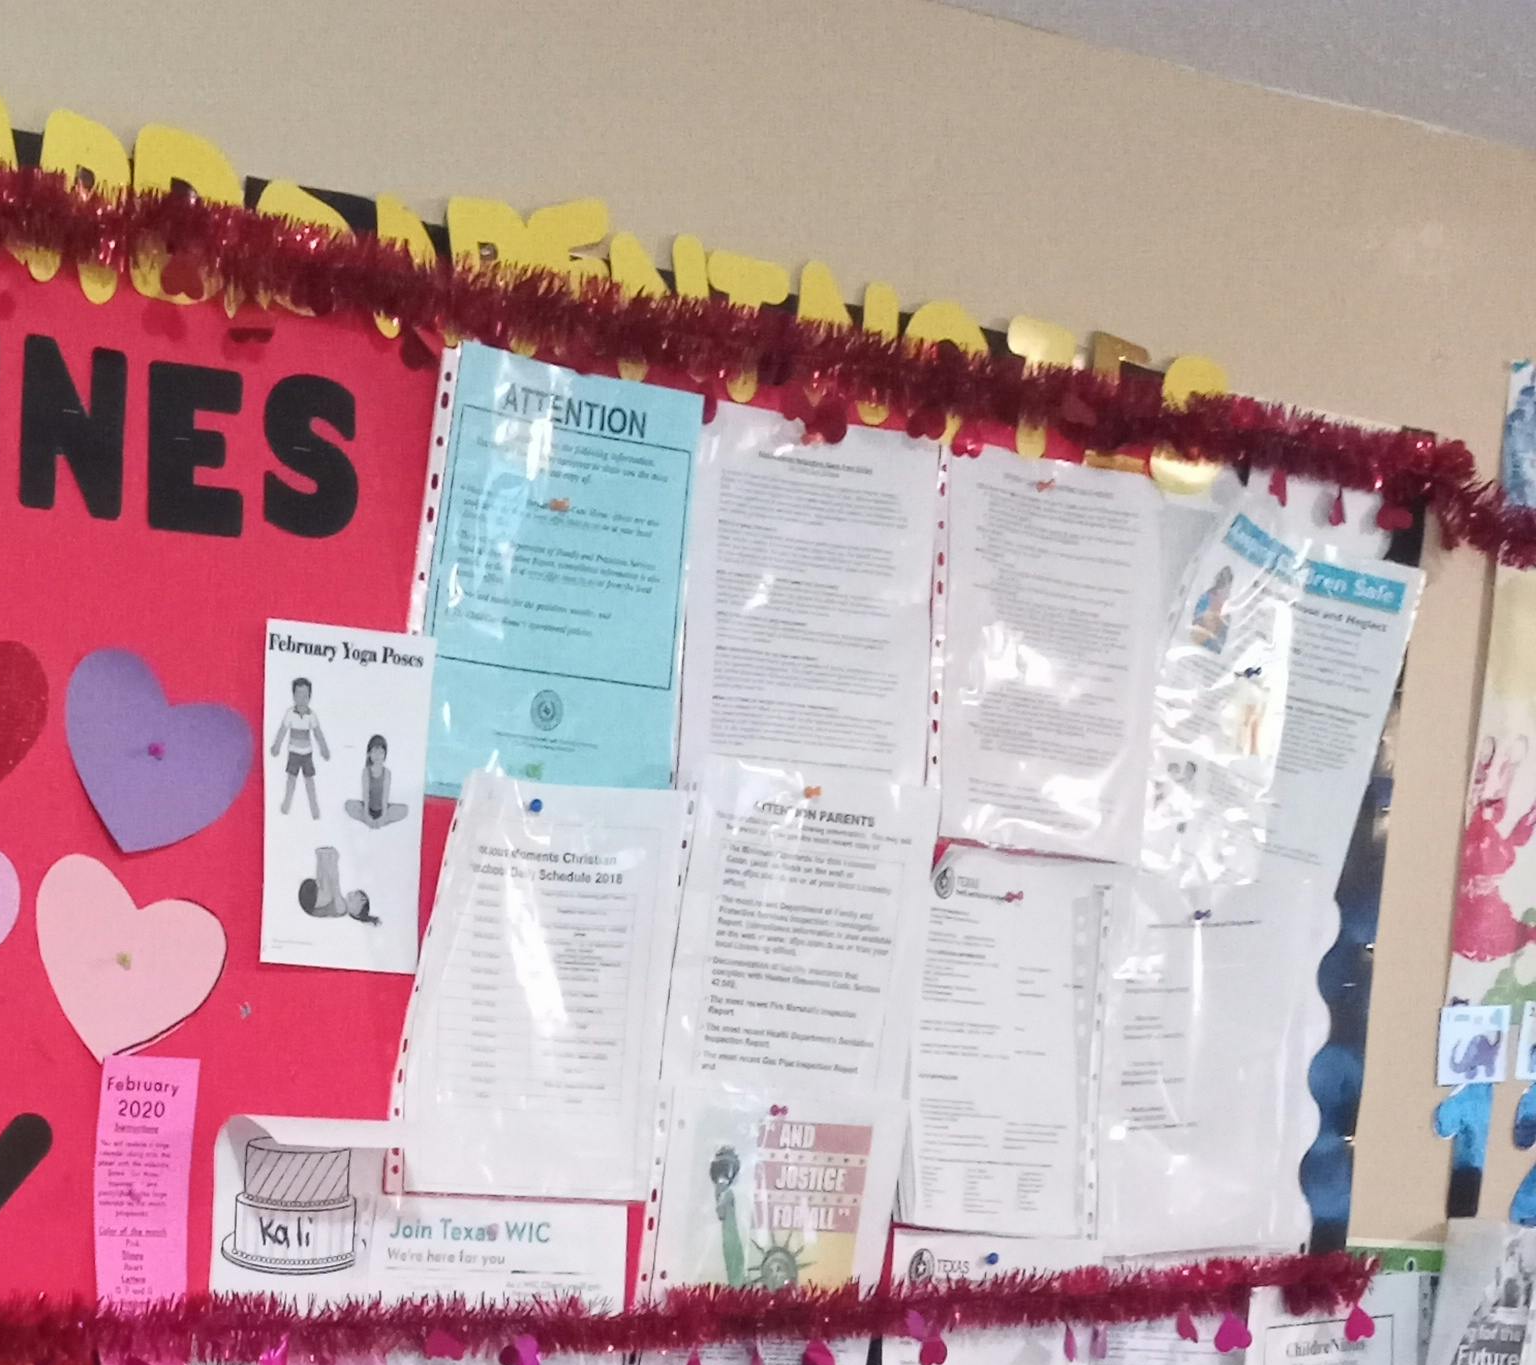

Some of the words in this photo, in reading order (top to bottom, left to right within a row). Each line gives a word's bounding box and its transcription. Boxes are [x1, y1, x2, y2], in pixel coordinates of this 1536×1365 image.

[268, 633, 337, 662] February
[341, 641, 378, 666] Yoga
[381, 646, 425, 668] Poses
[819, 810, 876, 828] PARENTS
[538, 869, 591, 883] Schedule
[107, 1075, 180, 1097] February
[117, 1100, 166, 1119] 2020
[775, 1168, 848, 1192] JUSTICE
[259, 1216, 313, 1250] Kali
[389, 1218, 433, 1241] Join
[441, 1219, 499, 1242] Texas
[505, 1221, 551, 1243] WIC
[459, 1248, 478, 1265] for
[479, 1253, 505, 1267] you
